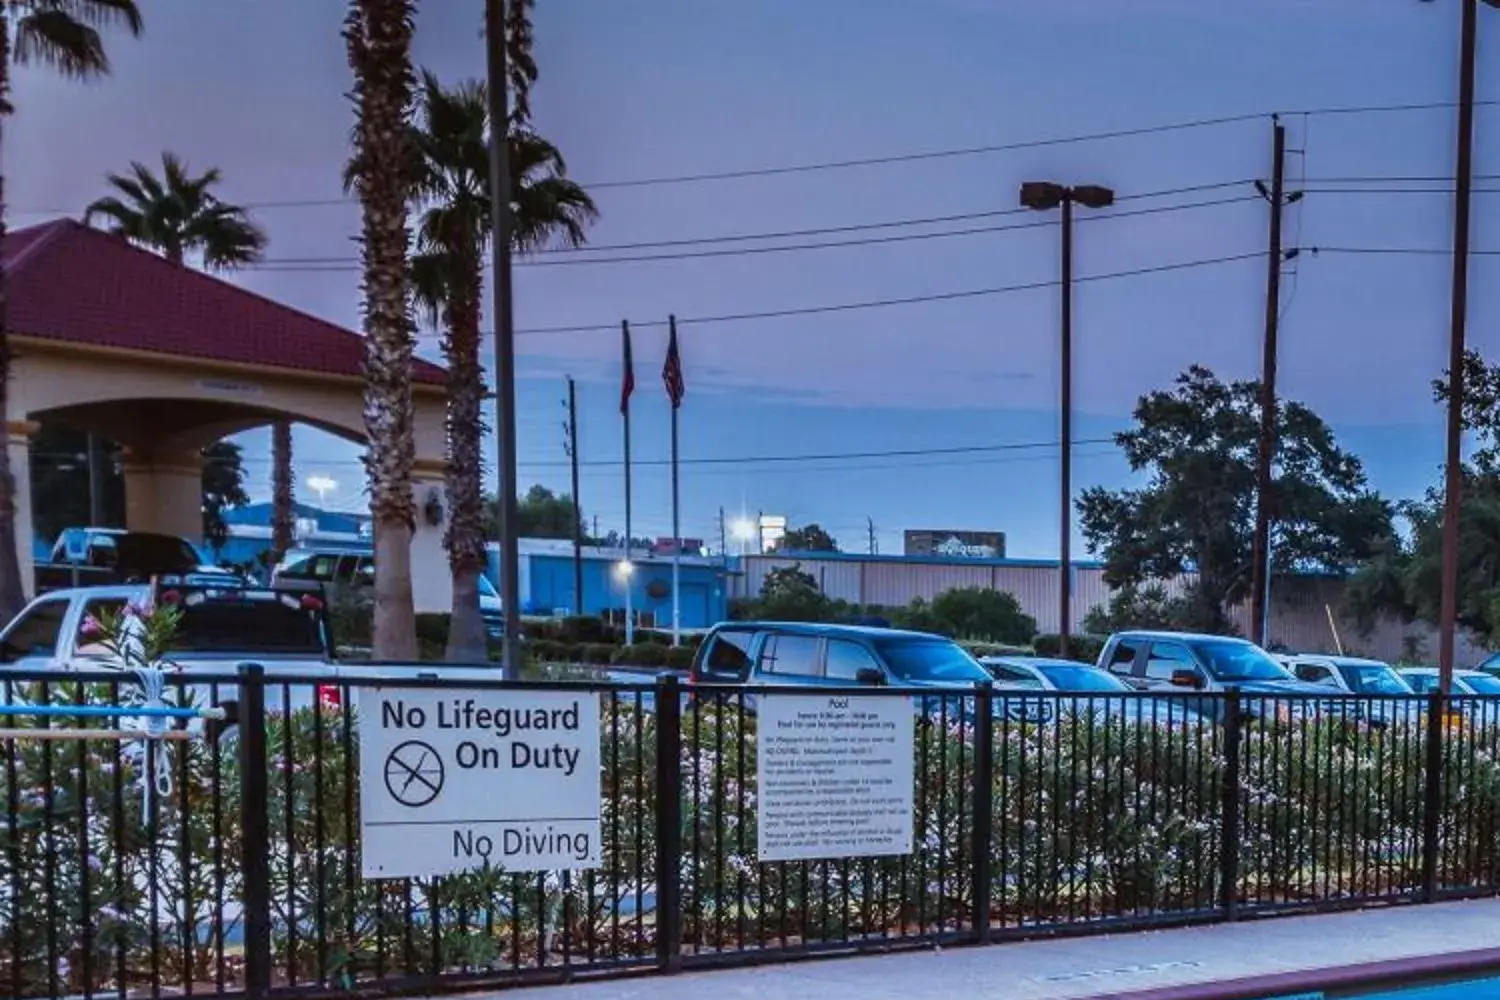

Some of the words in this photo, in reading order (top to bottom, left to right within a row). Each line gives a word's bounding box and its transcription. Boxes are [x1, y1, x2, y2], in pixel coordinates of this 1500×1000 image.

[382, 701, 426, 729] No
[437, 700, 579, 737] Lifeguard
[455, 741, 499, 769] On
[511, 741, 581, 776] Duty
[453, 830, 493, 858] No
[503, 826, 590, 861] Diving
